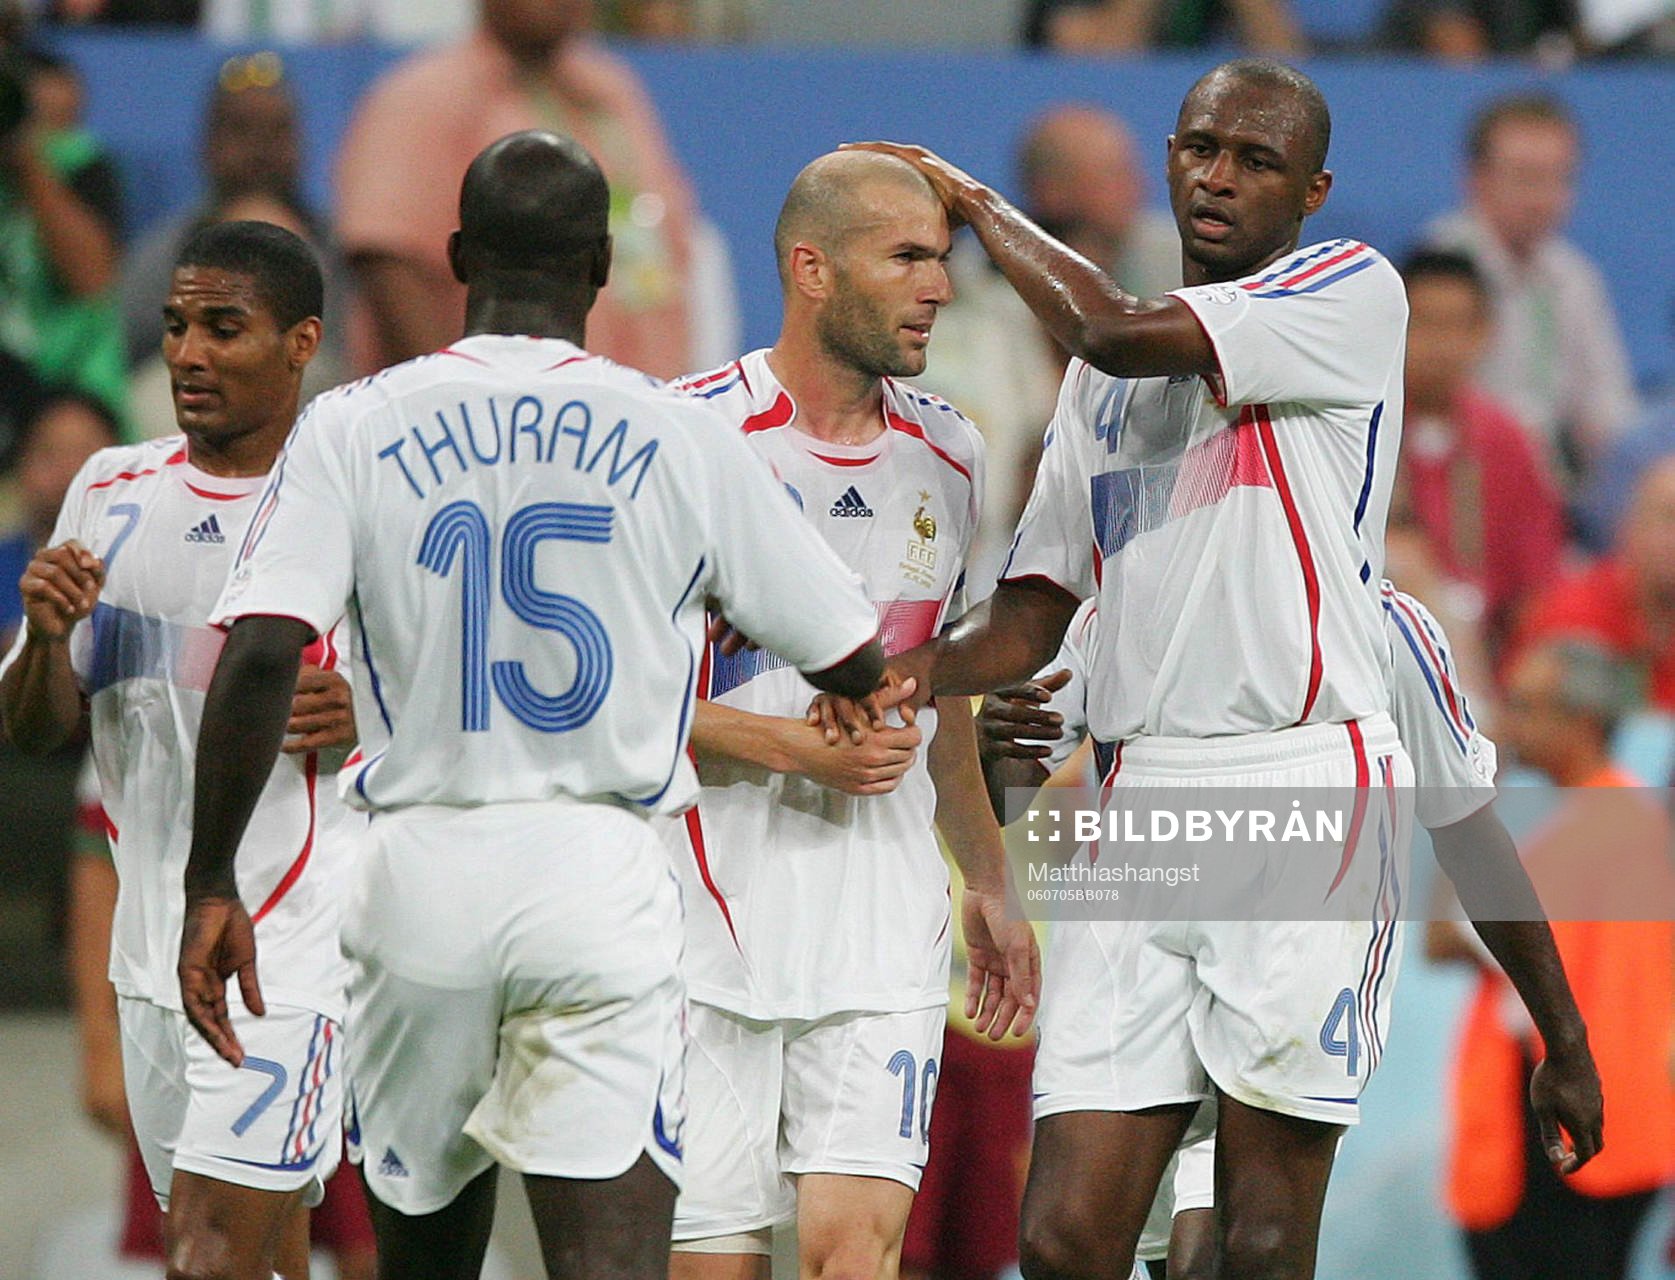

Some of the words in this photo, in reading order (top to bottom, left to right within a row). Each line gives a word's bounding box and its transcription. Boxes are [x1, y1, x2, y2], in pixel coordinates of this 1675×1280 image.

[378, 396, 659, 499] THURAM
[1095, 377, 1128, 454] 4
[103, 502, 141, 574] 7
[829, 505, 873, 517] adidas
[416, 500, 615, 733] 15
[1320, 987, 1361, 1076] 4
[230, 1055, 288, 1138] 7
